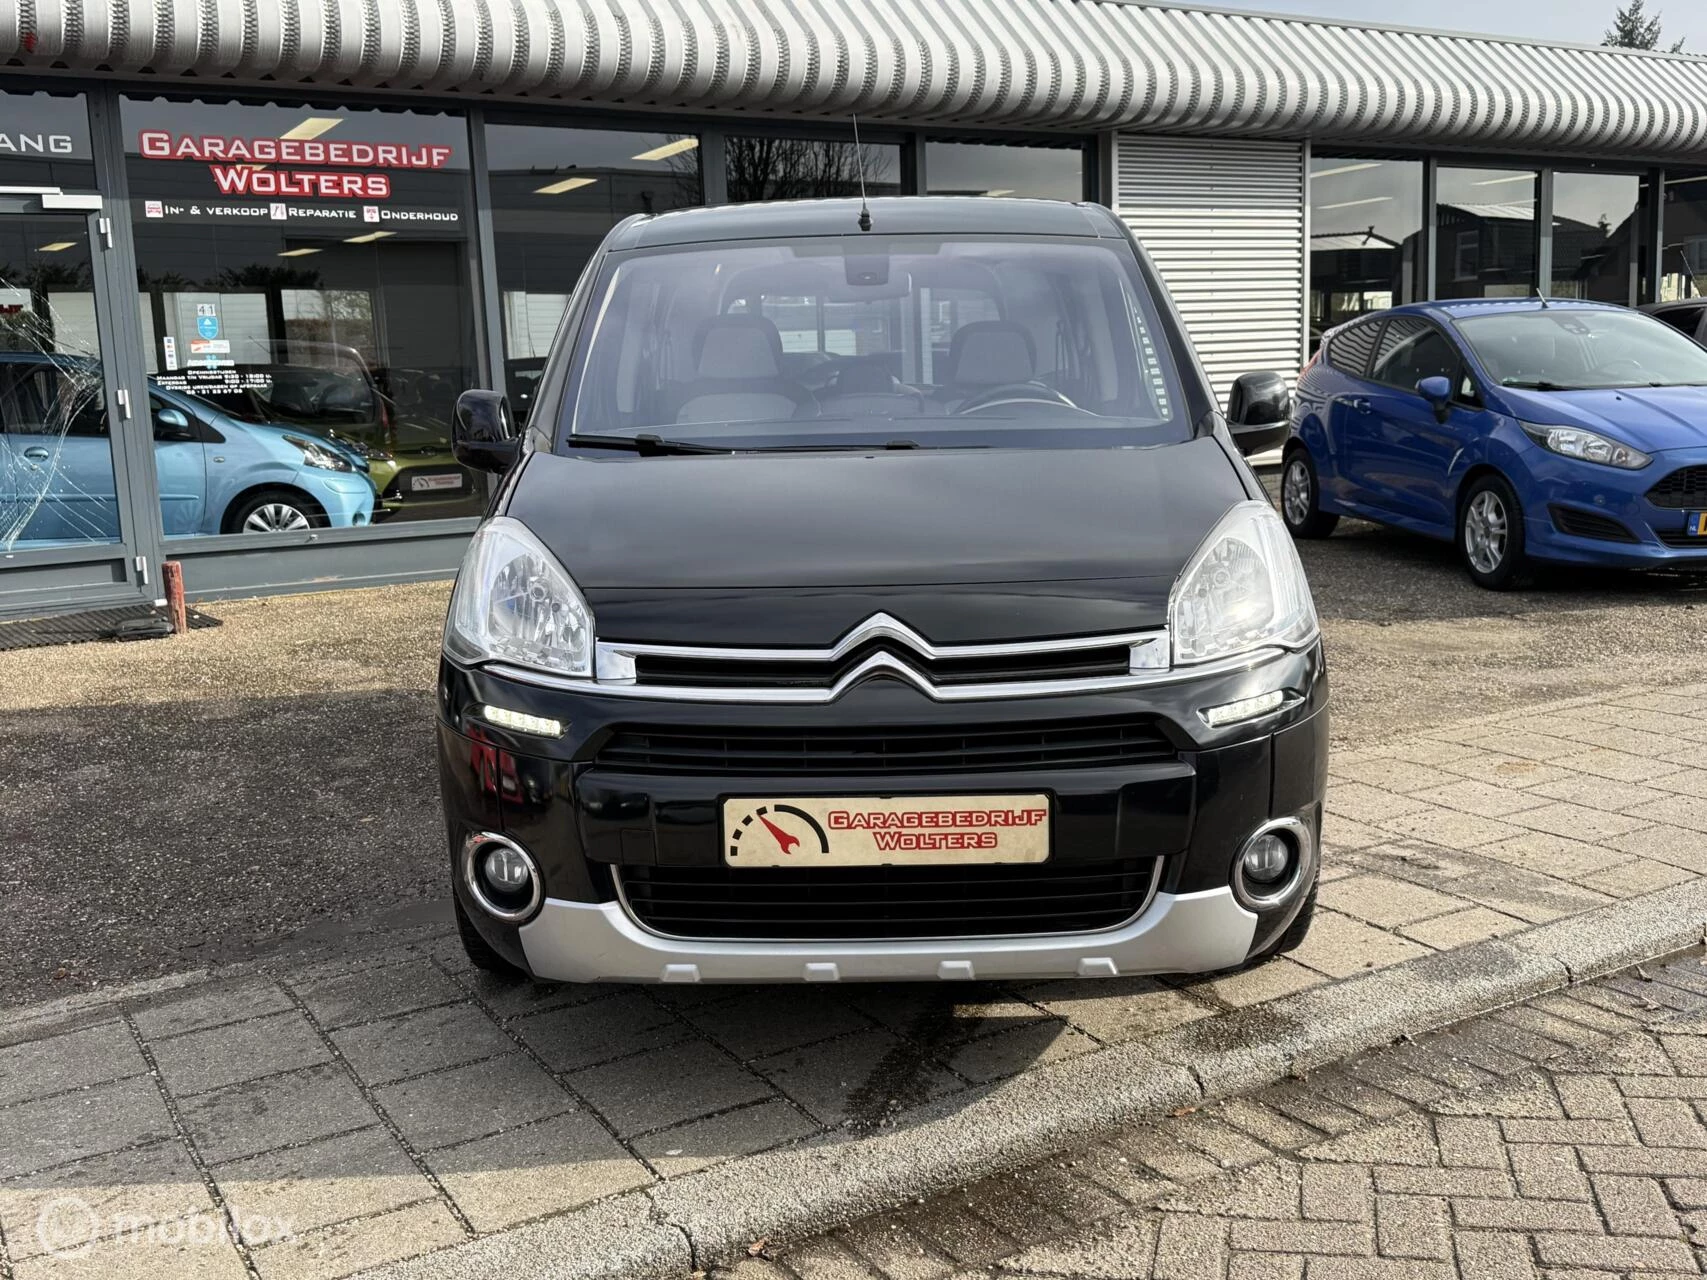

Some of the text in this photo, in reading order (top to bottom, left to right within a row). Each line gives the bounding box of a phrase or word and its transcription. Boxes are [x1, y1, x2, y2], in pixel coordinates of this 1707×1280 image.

[140, 131, 453, 168] GARAGEBEDRIJF
[212, 166, 389, 198] WOLTERS
[165, 205, 458, 221] IN- & VERKOOP REPARATIE ONDERHOUD
[828, 809, 1047, 830] GARAGEBEDRIJF
[873, 831, 997, 851] WOLTERS
